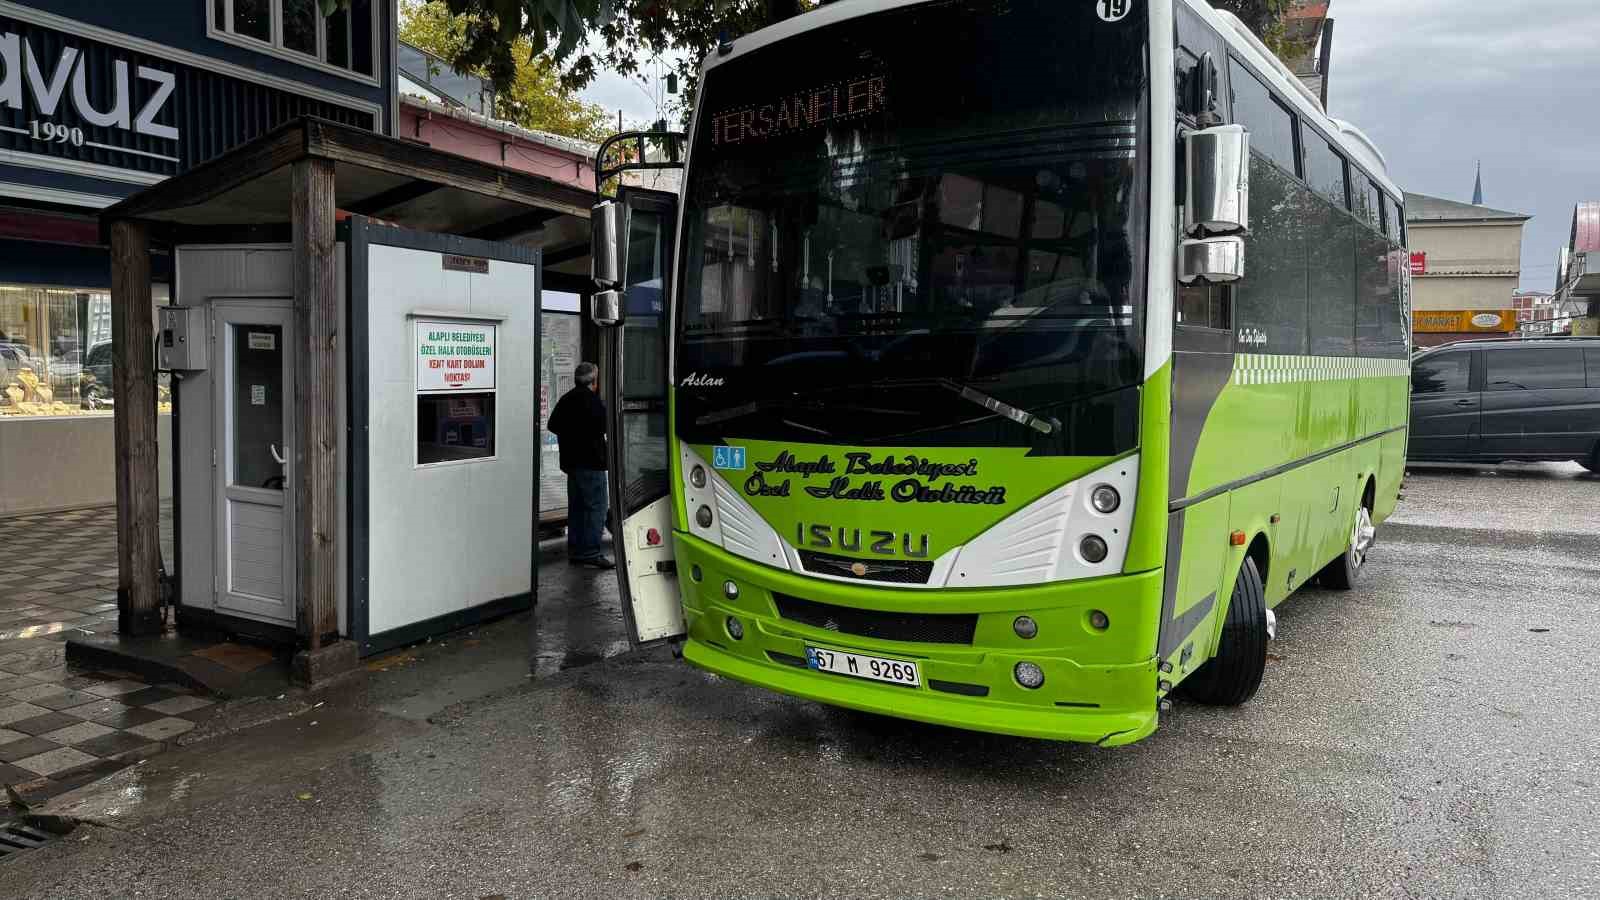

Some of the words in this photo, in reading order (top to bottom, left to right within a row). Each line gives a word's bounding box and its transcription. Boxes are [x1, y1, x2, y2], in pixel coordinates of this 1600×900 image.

[1102, 0, 1126, 18] 19
[712, 76, 886, 145] TERSANELER
[29, 120, 84, 148] 1990
[429, 360, 444, 368] KENT
[447, 360, 462, 368] KART
[464, 360, 485, 368] DOLUM
[438, 346, 454, 355] HALK
[680, 371, 725, 386] Aslan
[844, 452, 978, 481] Belediyesi
[745, 471, 790, 497] Özel
[804, 477, 886, 500] Halk
[891, 479, 1006, 504] Otobüsü
[797, 522, 930, 557] ISUZU
[816, 651, 834, 669] 67
[847, 655, 859, 674] M
[869, 659, 915, 682] 9269
